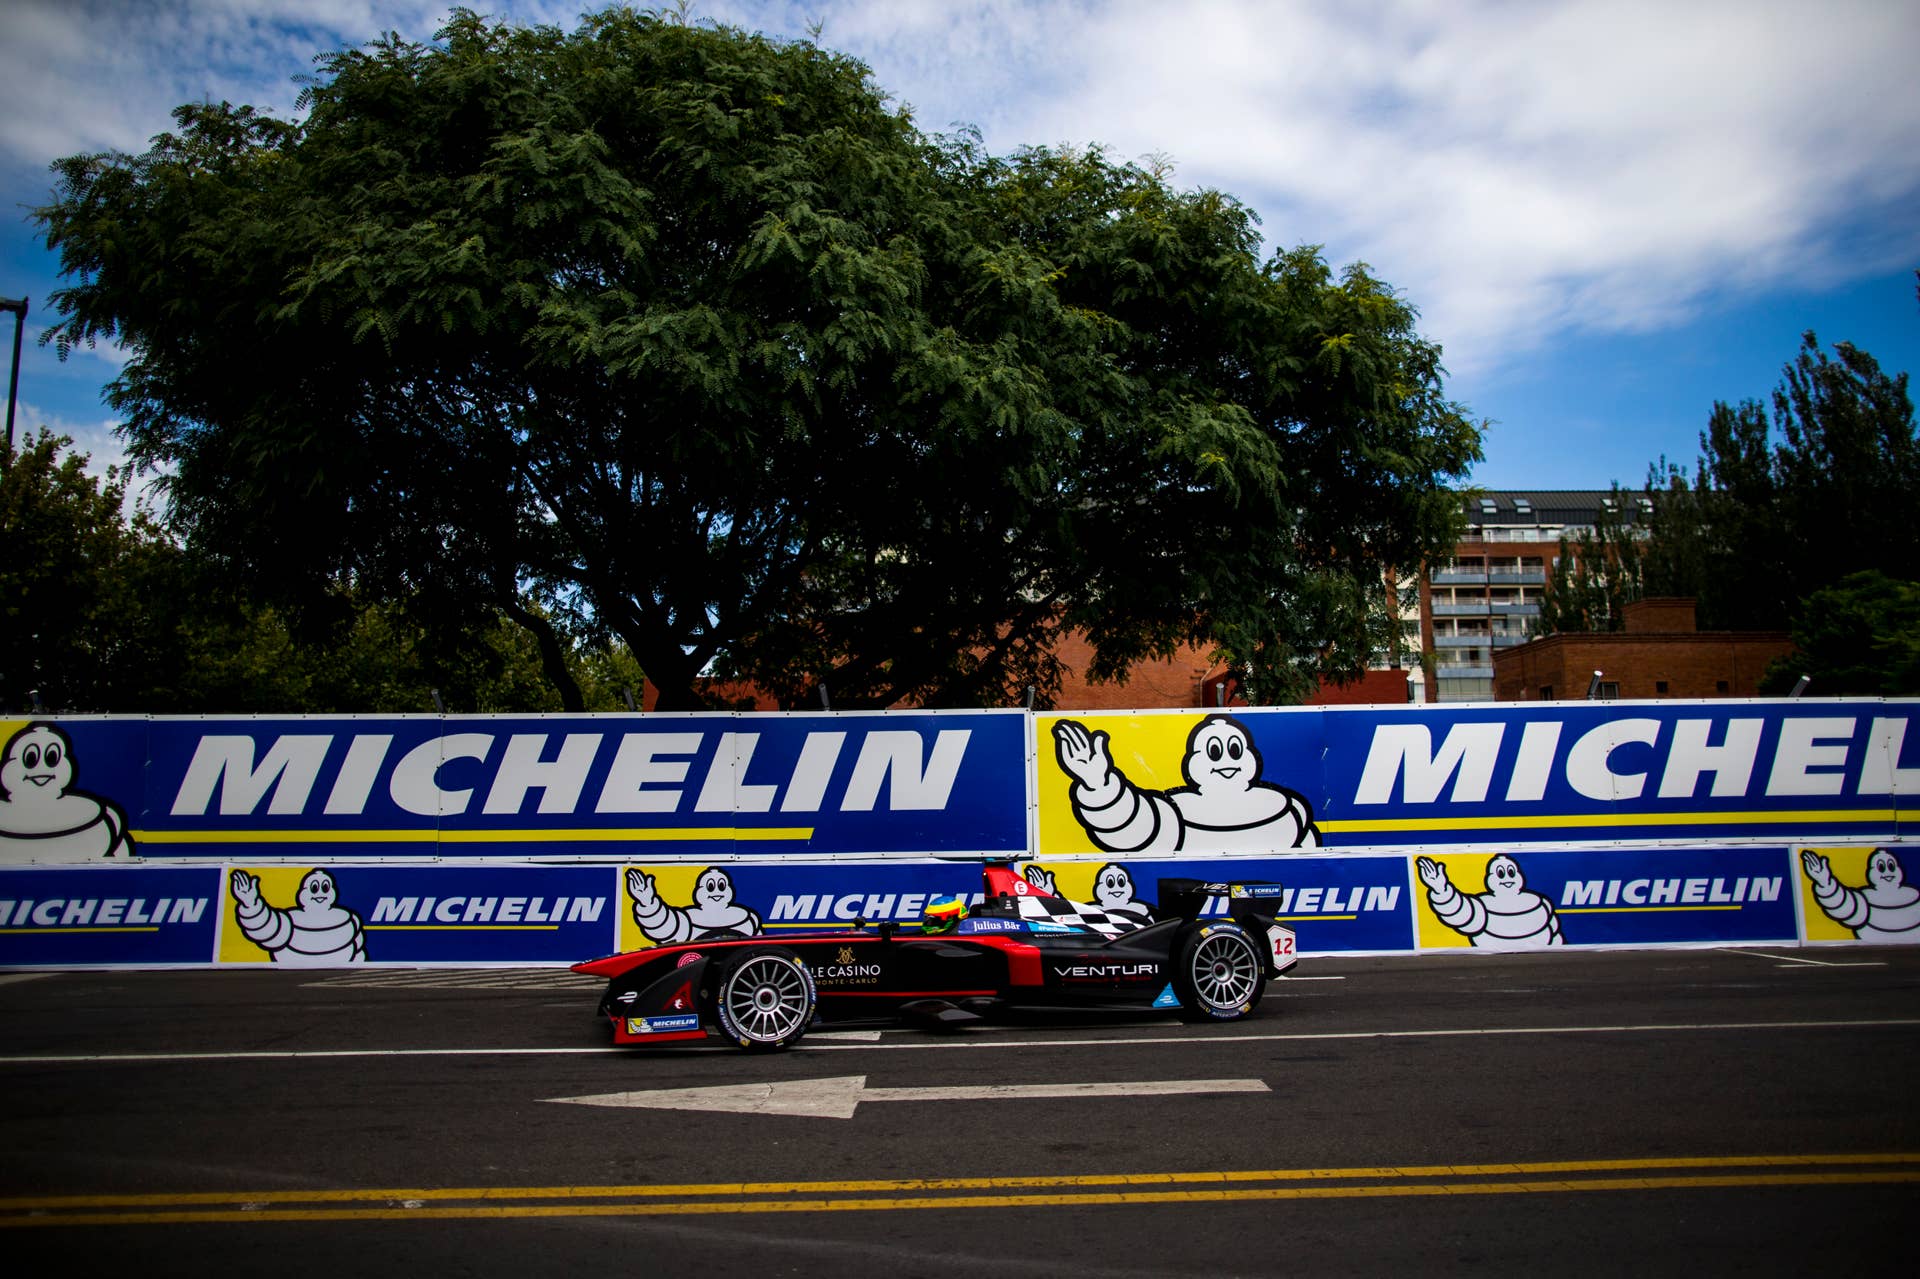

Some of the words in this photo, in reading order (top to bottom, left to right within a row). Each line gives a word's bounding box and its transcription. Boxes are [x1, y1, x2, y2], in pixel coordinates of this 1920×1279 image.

[1353, 717, 1920, 805] MICHEL
[170, 729, 973, 817] MICHELIN
[1561, 877, 1782, 905] MICHELIN
[370, 896, 606, 922] MICHELIN
[768, 893, 985, 920] MICHEI
[973, 920, 1002, 932] Julius
[1005, 920, 1021, 931] Bär
[1274, 937, 1293, 955] 12
[827, 964, 881, 978] CASINO
[1054, 964, 1159, 976] VENTURI
[652, 1018, 696, 1027] MICHELIN
